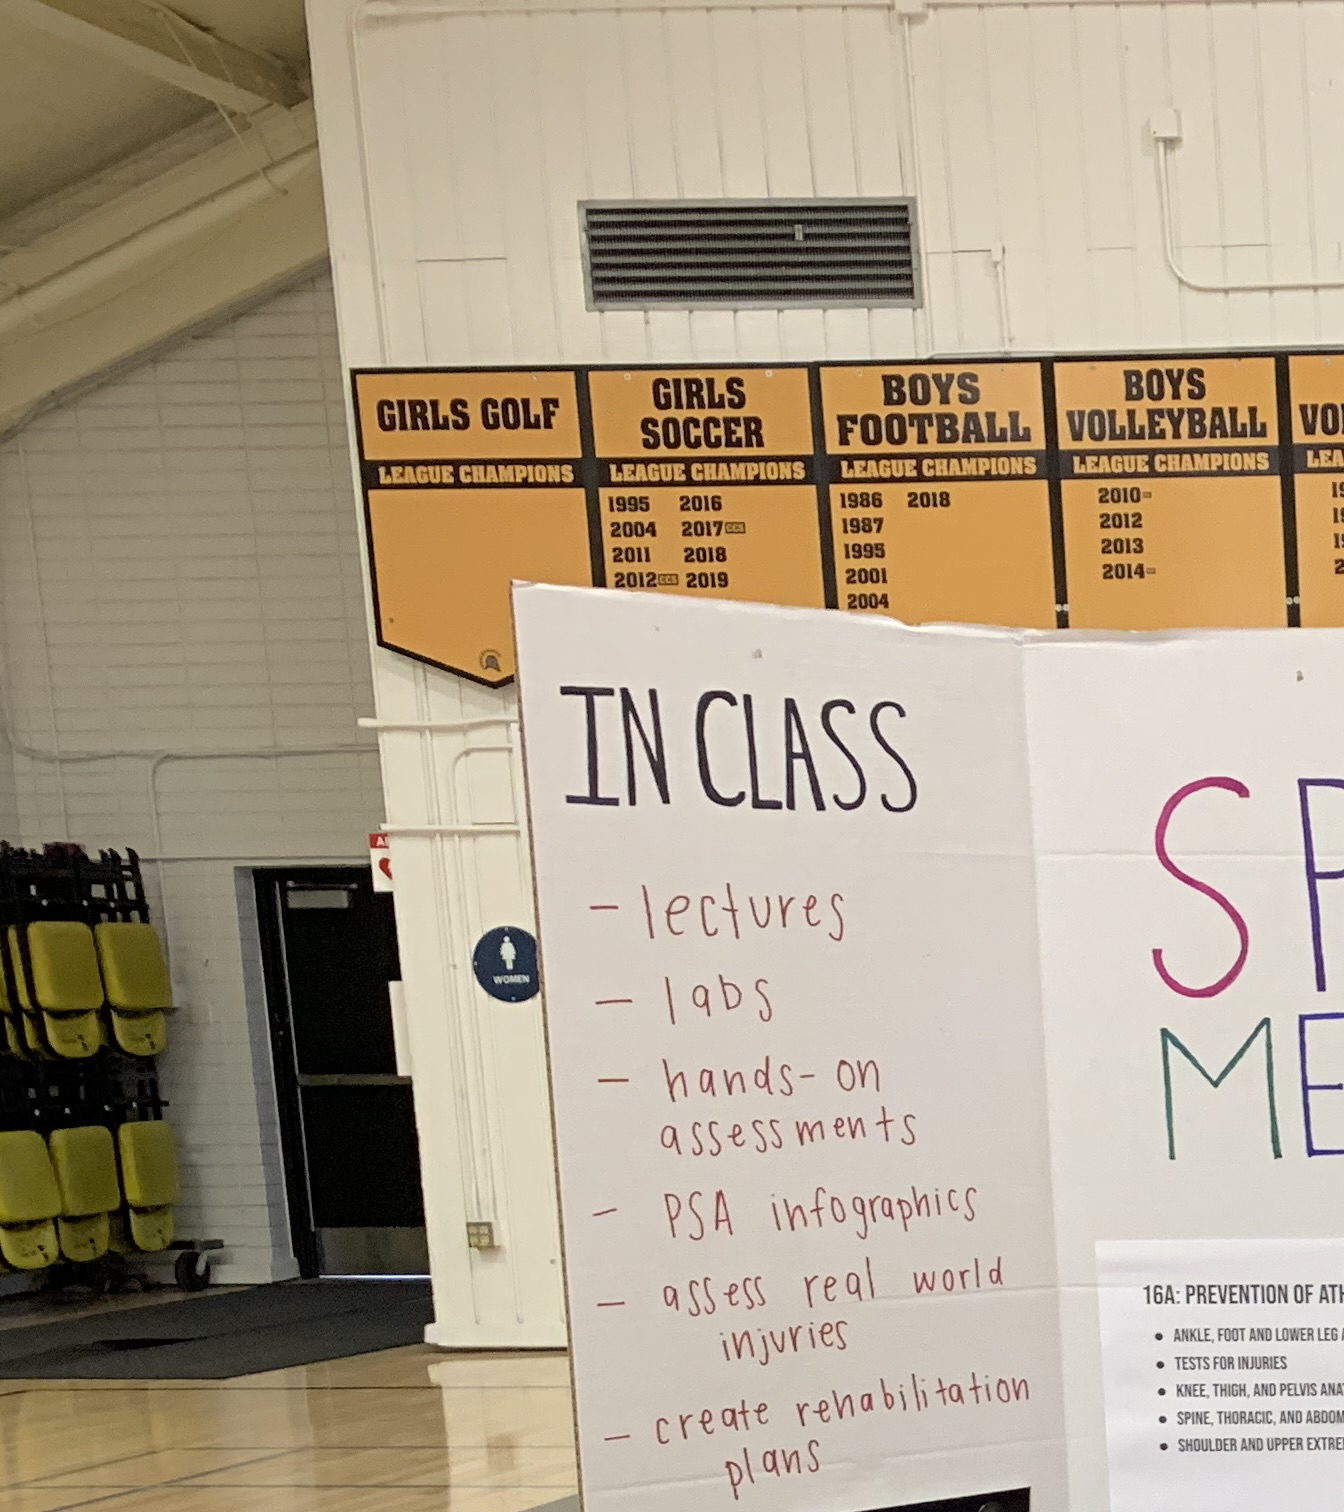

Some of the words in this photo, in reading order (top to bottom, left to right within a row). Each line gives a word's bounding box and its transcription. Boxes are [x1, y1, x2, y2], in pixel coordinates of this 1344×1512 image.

[652, 377, 746, 410] GIRLS
[883, 372, 981, 407] BOYS
[1123, 368, 1206, 401] BOYS
[377, 400, 469, 432] GIRLS
[481, 399, 560, 431] GOLF
[837, 411, 1031, 446] FOOTBALL
[1066, 406, 1267, 442] VOLLEYBALL
[641, 416, 765, 450] SOCCER
[379, 464, 453, 485] LEAGUE
[460, 463, 574, 484] CHAMPIONS
[608, 496, 650, 513] 1995
[680, 495, 722, 512] 2016
[840, 492, 883, 509] 1986
[908, 491, 950, 508] 2018
[1100, 513, 1142, 529] 2012
[560, 686, 671, 806] IN
[695, 690, 918, 813] CLASS
[641, 882, 847, 942] lectures
[493, 974, 529, 984] WOMEN
[665, 973, 774, 1024] labs
[661, 1105, 917, 1157] assessments
[664, 1189, 733, 1240] PSA
[771, 1185, 978, 1239] infographics
[662, 1275, 767, 1316] assess
[805, 1256, 875, 1308] real
[913, 1256, 1005, 1295] world
[1143, 1285, 1180, 1305] 16A:
[1186, 1284, 1288, 1304] PREVENTION
[1294, 1284, 1313, 1304] OF
[721, 1319, 848, 1366] injuries
[1174, 1328, 1215, 1344] ANKLE,
[1218, 1328, 1245, 1342] FOOT
[1249, 1328, 1272, 1342] AND
[1275, 1328, 1314, 1342] LOWER
[1317, 1327, 1338, 1341] LEG
[1176, 1384, 1209, 1399] KNEE,
[1213, 1384, 1250, 1399] THIGH,
[1253, 1383, 1276, 1397] AND
[1279, 1383, 1317, 1397] PELVIS
[656, 1399, 769, 1445] create
[795, 1373, 1031, 1428] rehabilitation
[725, 1439, 821, 1500] plans
